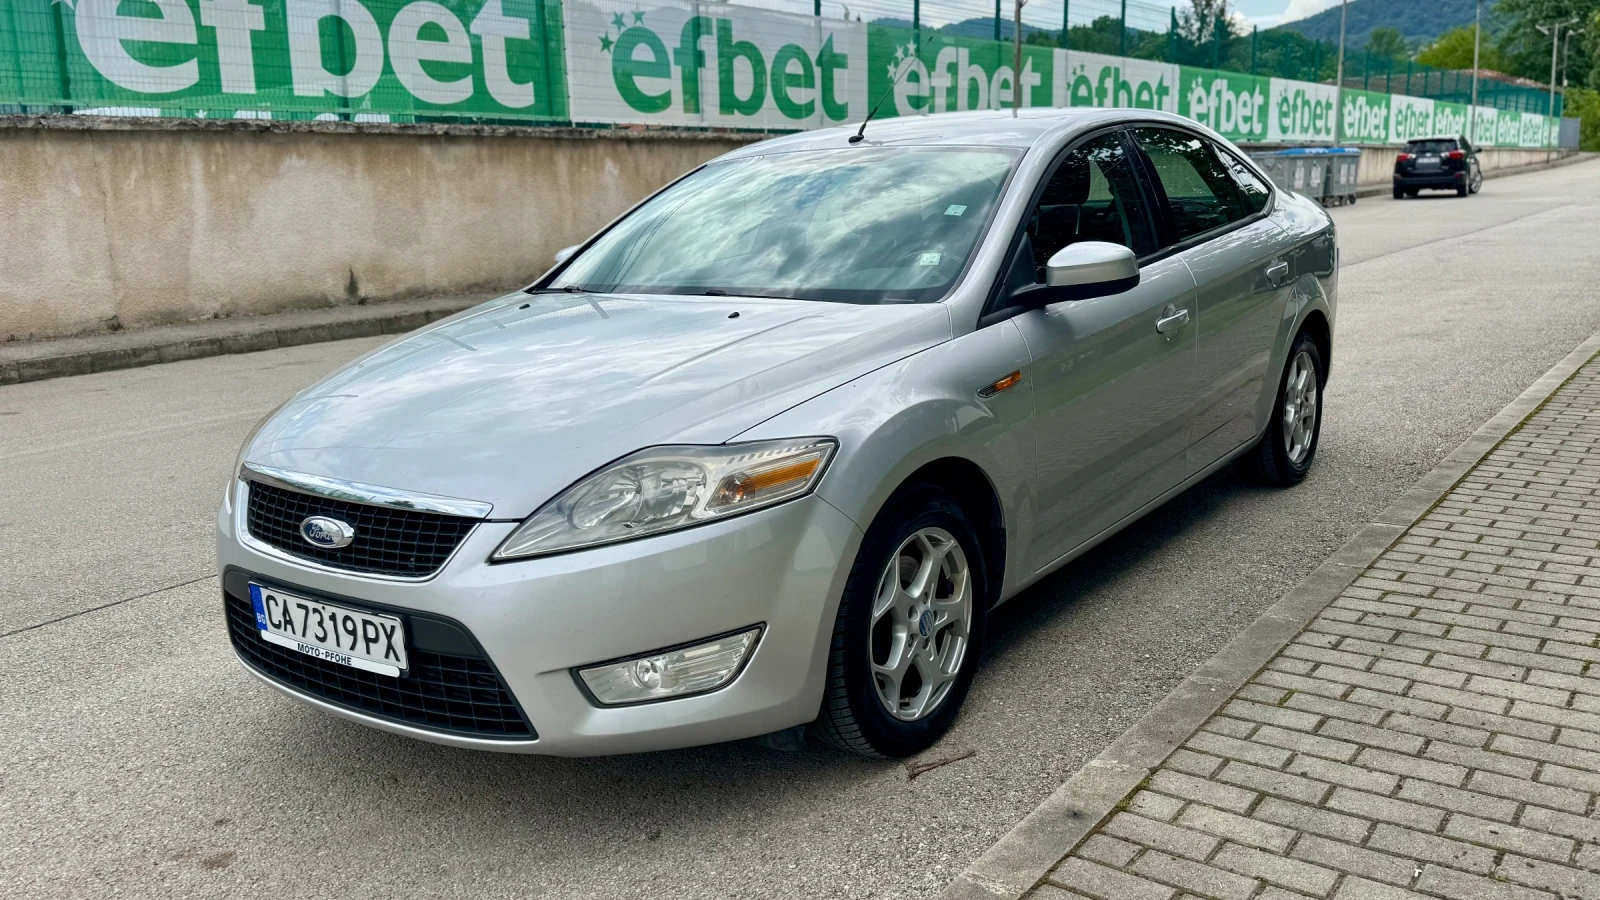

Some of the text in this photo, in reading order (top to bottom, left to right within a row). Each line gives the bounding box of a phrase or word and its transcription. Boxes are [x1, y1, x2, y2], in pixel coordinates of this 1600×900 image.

[75, 0, 536, 108] efbet
[612, 16, 849, 122] efbet
[893, 46, 1041, 116] efbet
[1070, 66, 1170, 110] efbet
[1190, 78, 1264, 135] efbet
[1278, 89, 1332, 136] efbet
[1343, 96, 1388, 139] efbet
[1396, 103, 1430, 139] efbet
[256, 612, 266, 625] BG
